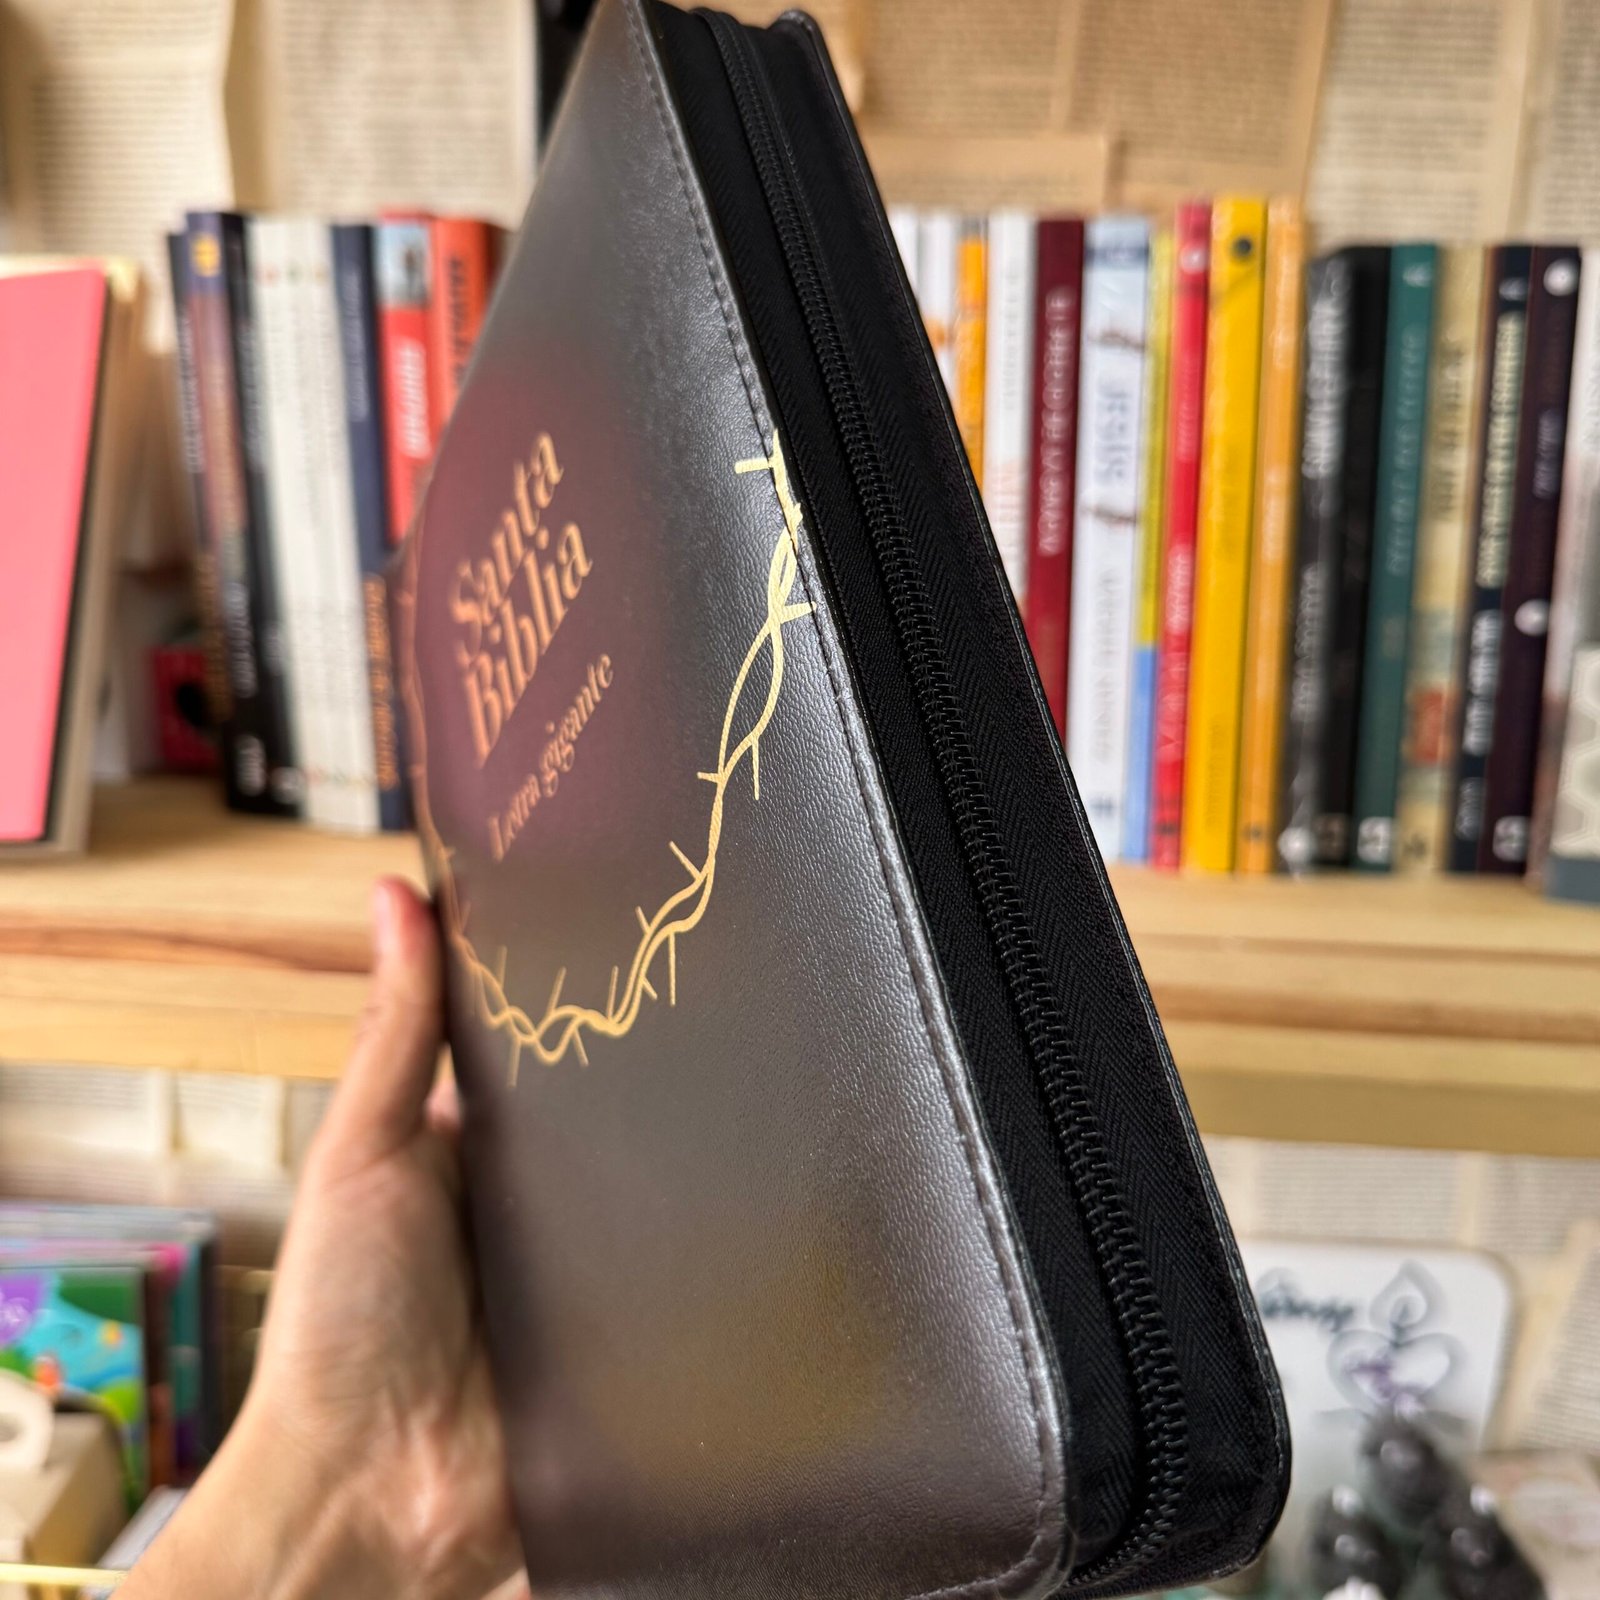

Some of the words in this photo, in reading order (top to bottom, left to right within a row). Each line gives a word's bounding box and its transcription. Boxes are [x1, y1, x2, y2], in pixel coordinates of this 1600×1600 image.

[450, 432, 564, 667] Santa
[463, 521, 593, 770] Biblia
[487, 772, 542, 863] Letra
[538, 653, 614, 798] gigante
